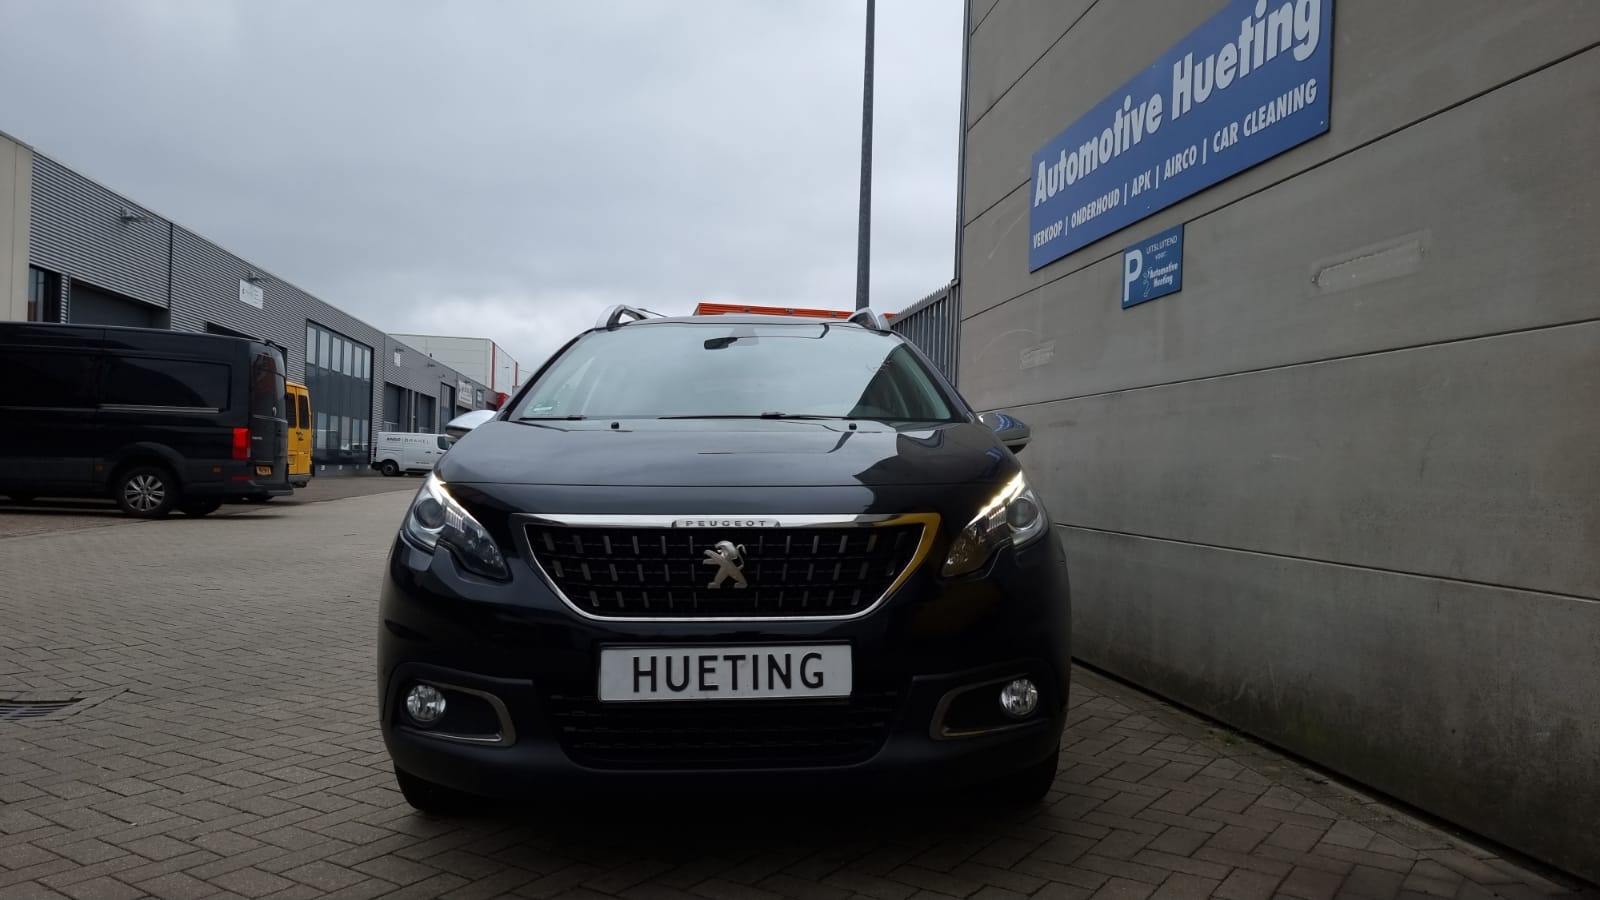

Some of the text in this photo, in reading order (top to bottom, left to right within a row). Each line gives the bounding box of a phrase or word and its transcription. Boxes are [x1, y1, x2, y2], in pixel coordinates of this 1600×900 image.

[1034, 0, 1320, 207] Automotive Hueting
[1033, 219, 1063, 248] VERKOOP
[1071, 188, 1120, 228] ONDERHOUD
[1131, 169, 1151, 198] APK
[1164, 145, 1197, 181] AIRCO
[1213, 121, 1239, 153] CAR
[1243, 78, 1317, 137] CLEANING
[1124, 249, 1143, 302] P
[633, 652, 824, 693] HUETING
